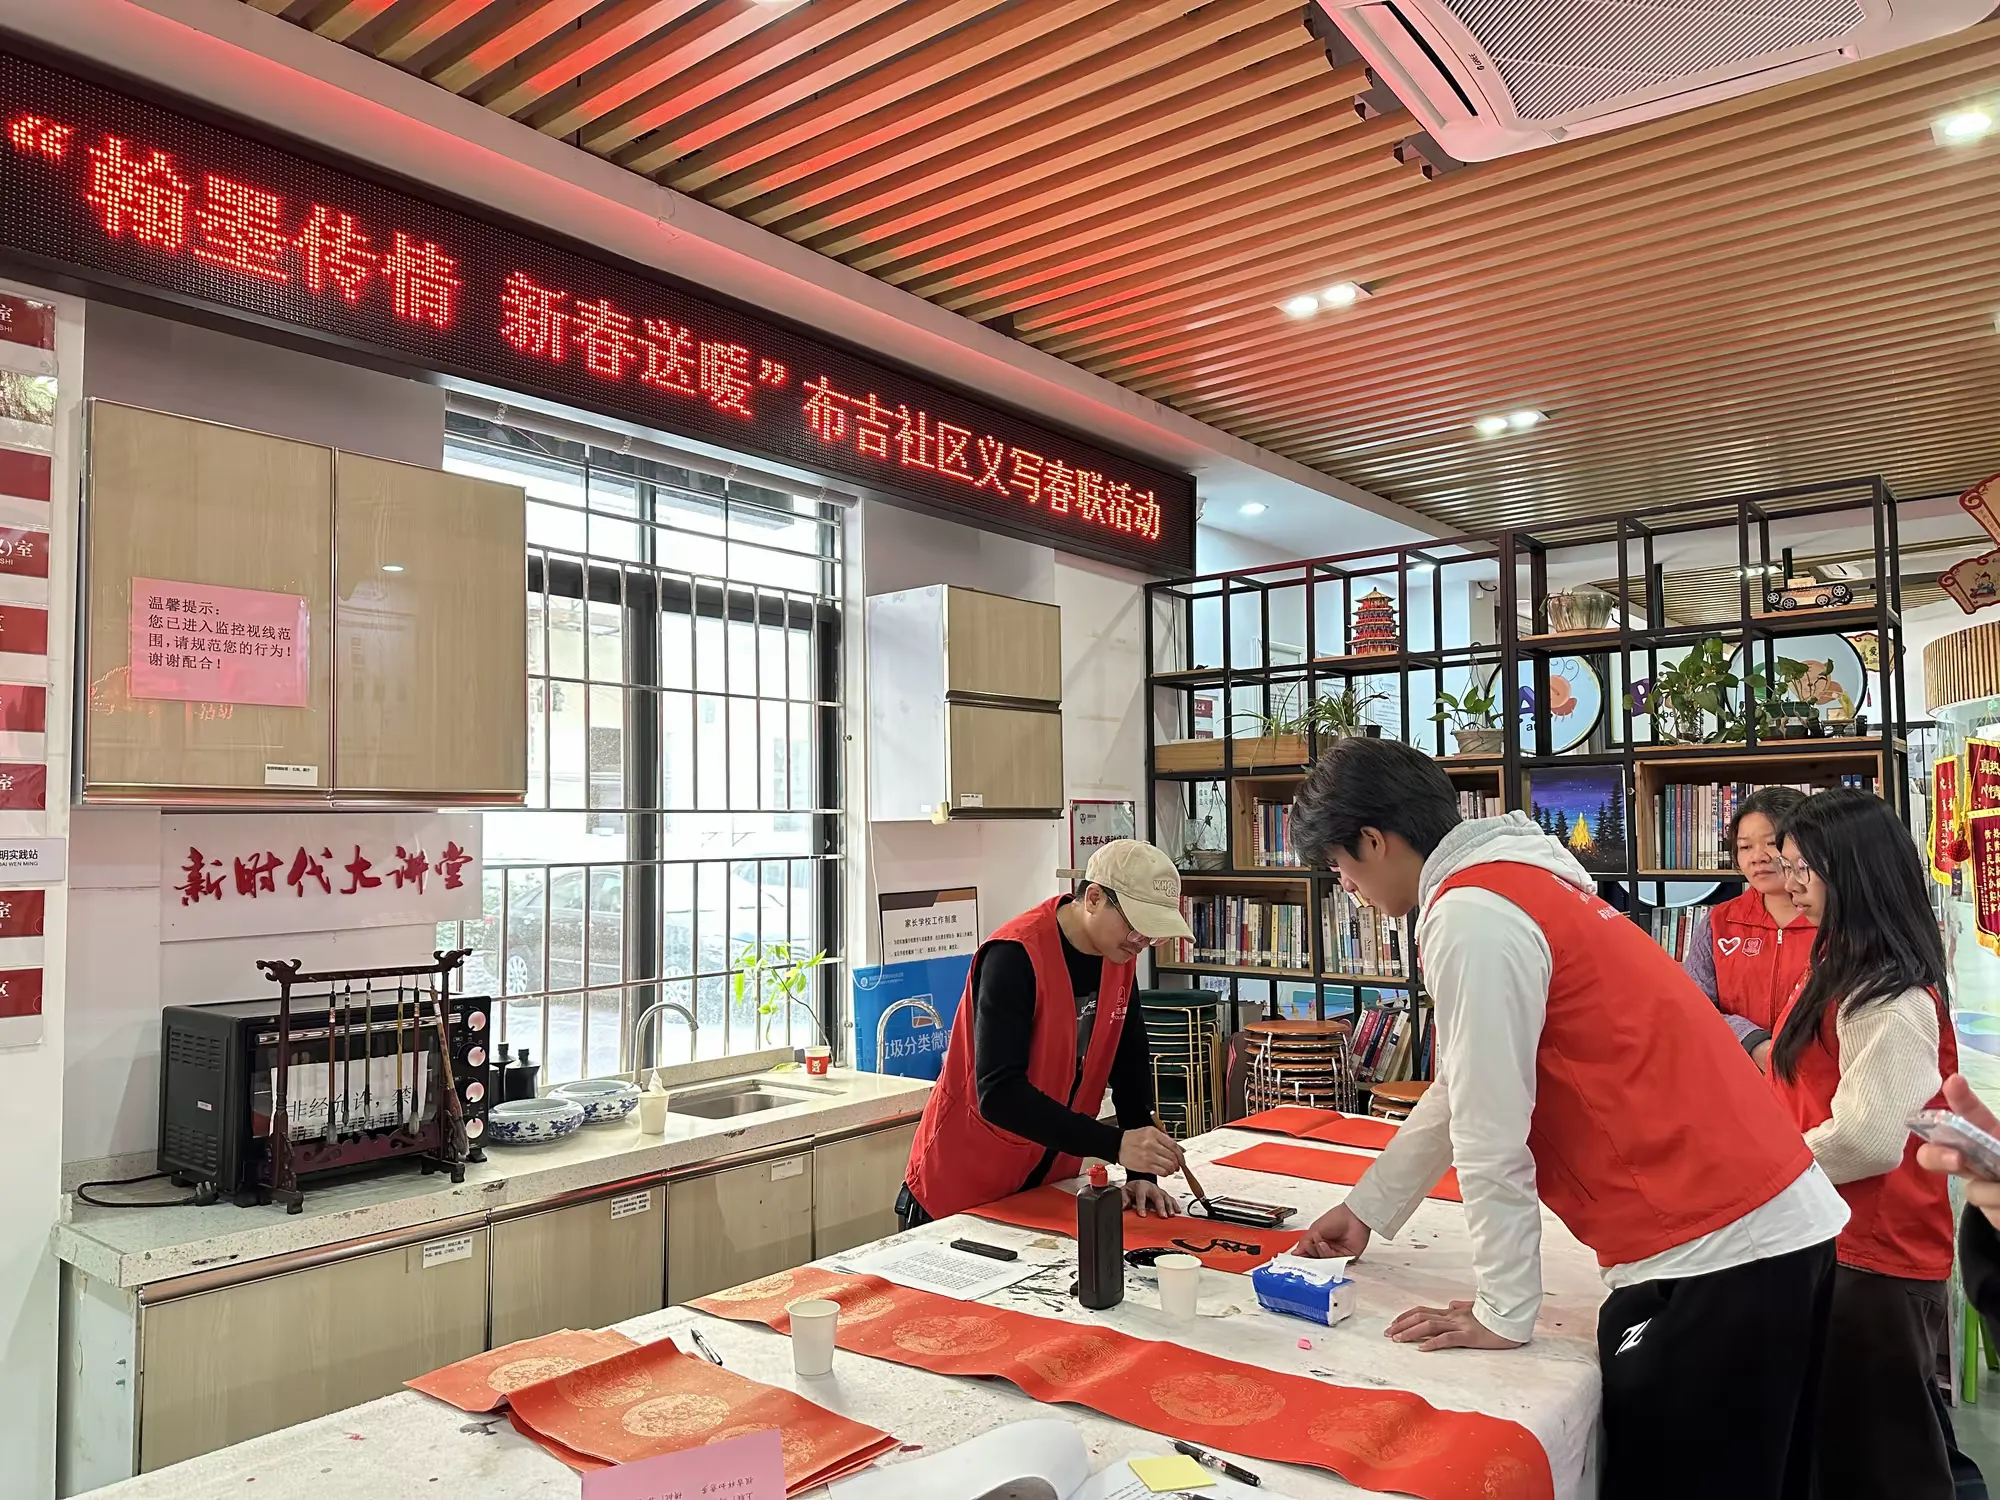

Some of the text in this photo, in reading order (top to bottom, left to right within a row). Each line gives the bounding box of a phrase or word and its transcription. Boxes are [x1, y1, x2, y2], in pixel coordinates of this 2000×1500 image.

[8, 112, 461, 331] “翰墨传情
[148, 596, 220, 616] 温馨提示：
[148, 614, 291, 642] 您已进入监控视线范
[173, 840, 473, 907] 新时代大讲堂
[904, 914, 958, 928] 家长学校工作制度
